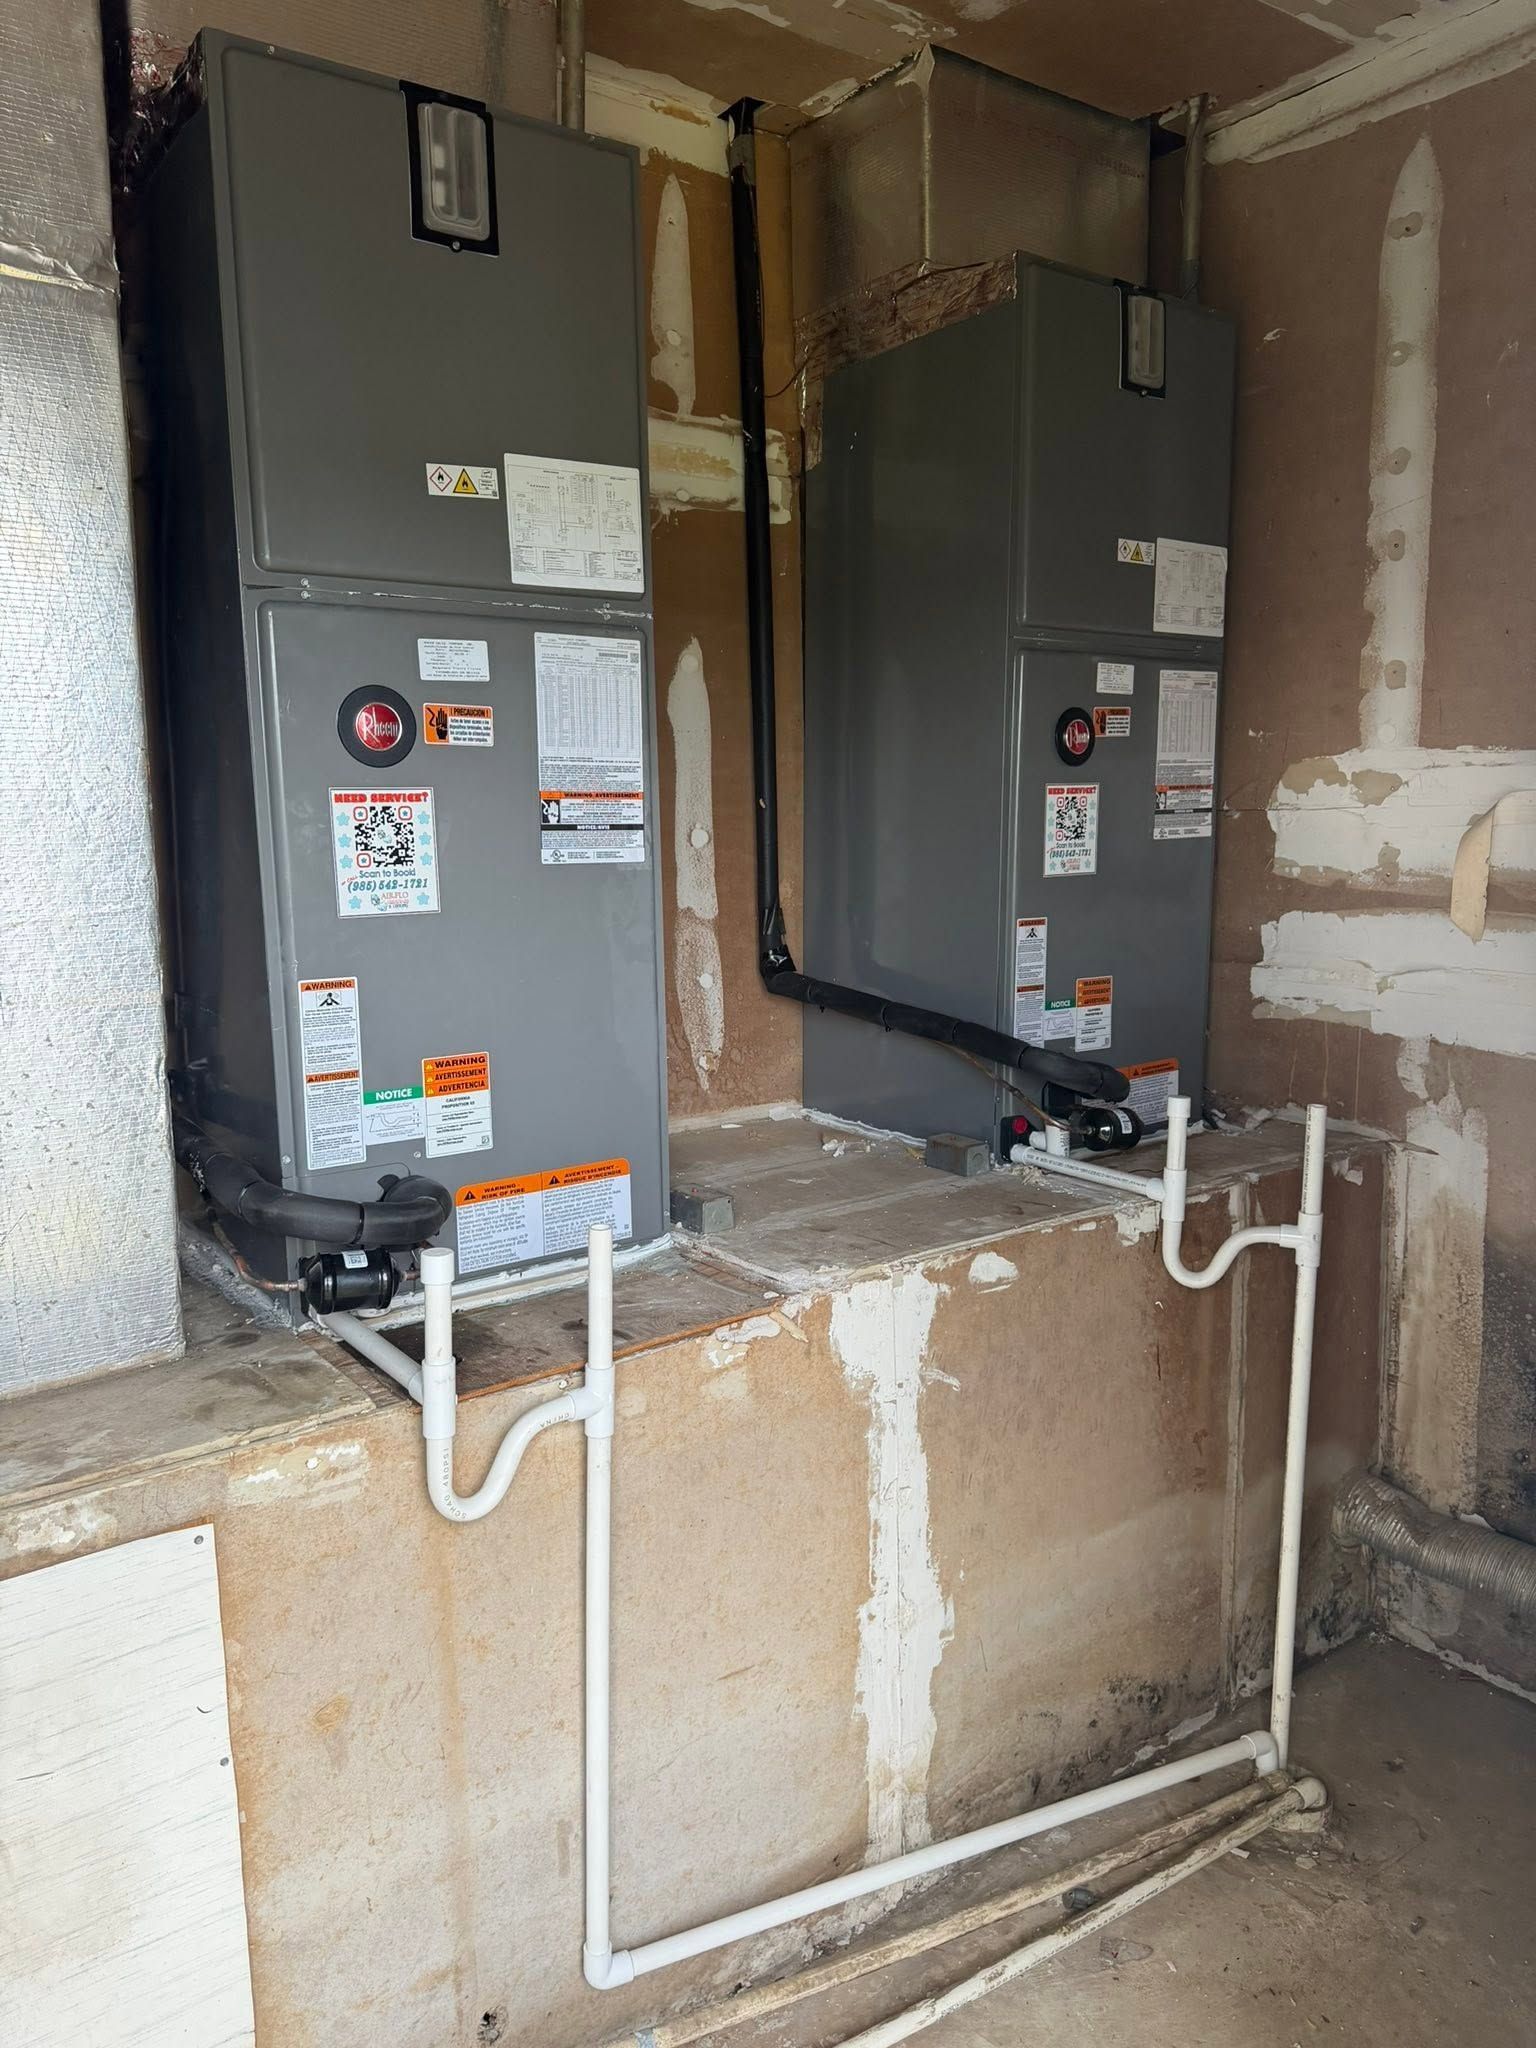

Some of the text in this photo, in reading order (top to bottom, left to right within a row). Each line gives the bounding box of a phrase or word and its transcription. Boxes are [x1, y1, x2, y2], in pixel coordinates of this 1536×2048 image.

[359, 706, 398, 743] Rheem
[334, 792, 429, 803] NEED SERVICE?
[359, 870, 381, 878] Scan
[382, 869, 391, 878] to
[347, 878, 428, 894] (985) 542-1721
[311, 980, 352, 990] WARNING
[1050, 999, 1071, 1009] NOTICE
[434, 1056, 486, 1068] WARNING
[315, 1070, 358, 1081] AVERTISSEMENT
[435, 1068, 486, 1081] AVERTISSEMENT
[438, 1080, 486, 1092] ADVERTENCIA
[375, 1088, 413, 1101] NOTICE
[564, 1164, 615, 1178] AVERTISSEMENT
[484, 1183, 517, 1194] WARNING
[510, 1187, 524, 1195] FIRE
